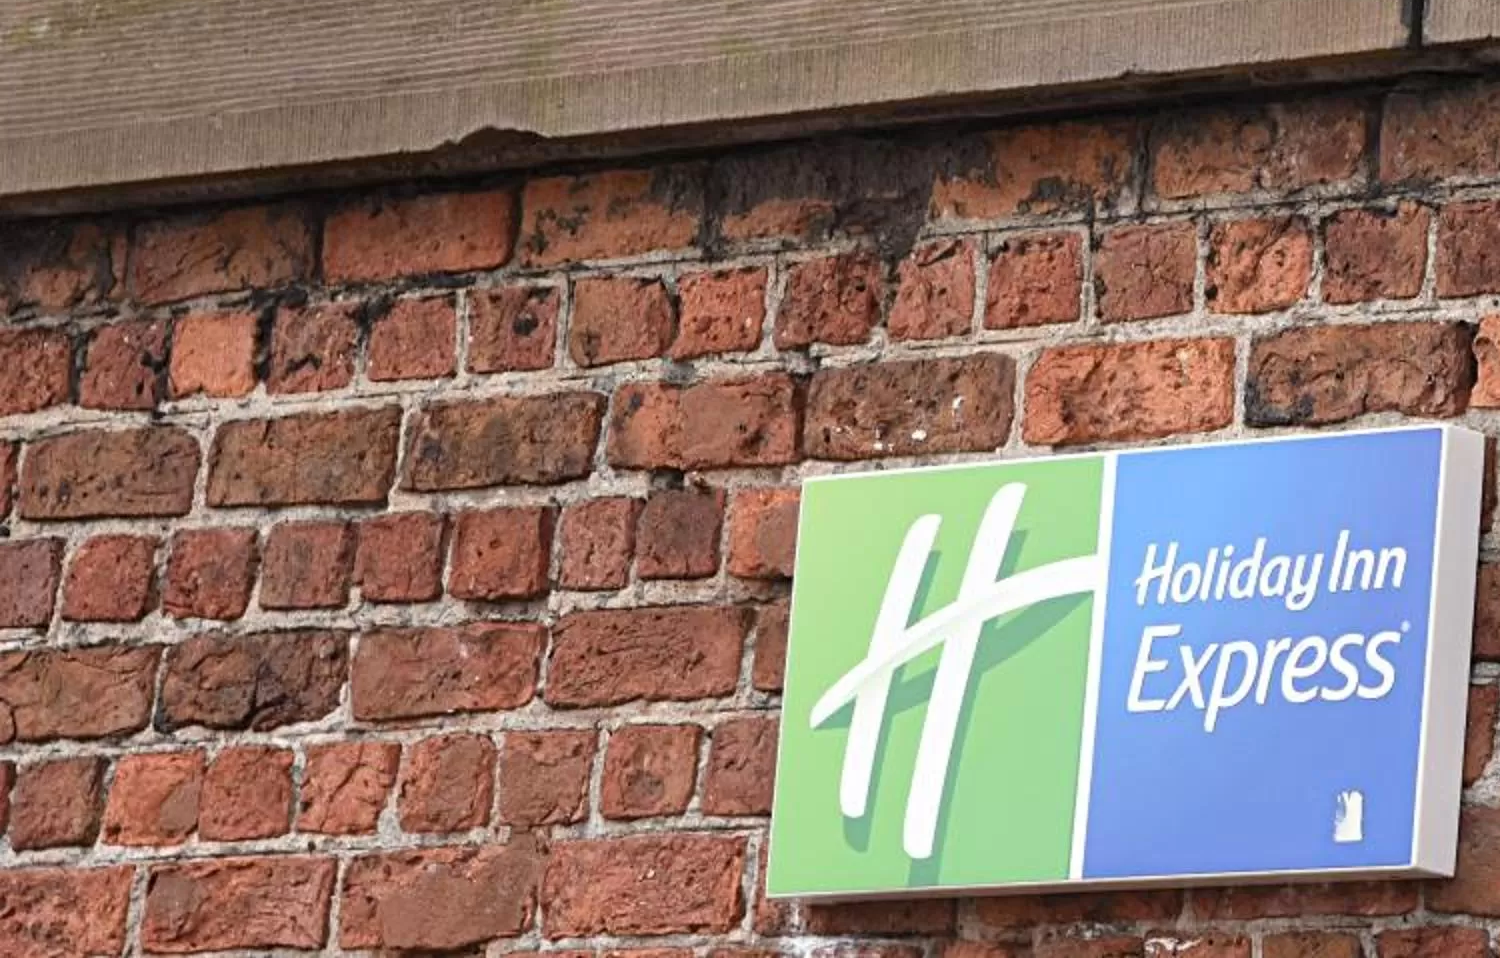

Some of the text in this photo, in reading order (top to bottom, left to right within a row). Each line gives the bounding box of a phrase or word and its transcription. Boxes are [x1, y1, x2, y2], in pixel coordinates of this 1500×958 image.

[1134, 529, 1407, 611] Holiday Inn
[810, 482, 1099, 859] H
[1127, 624, 1401, 732] Express
